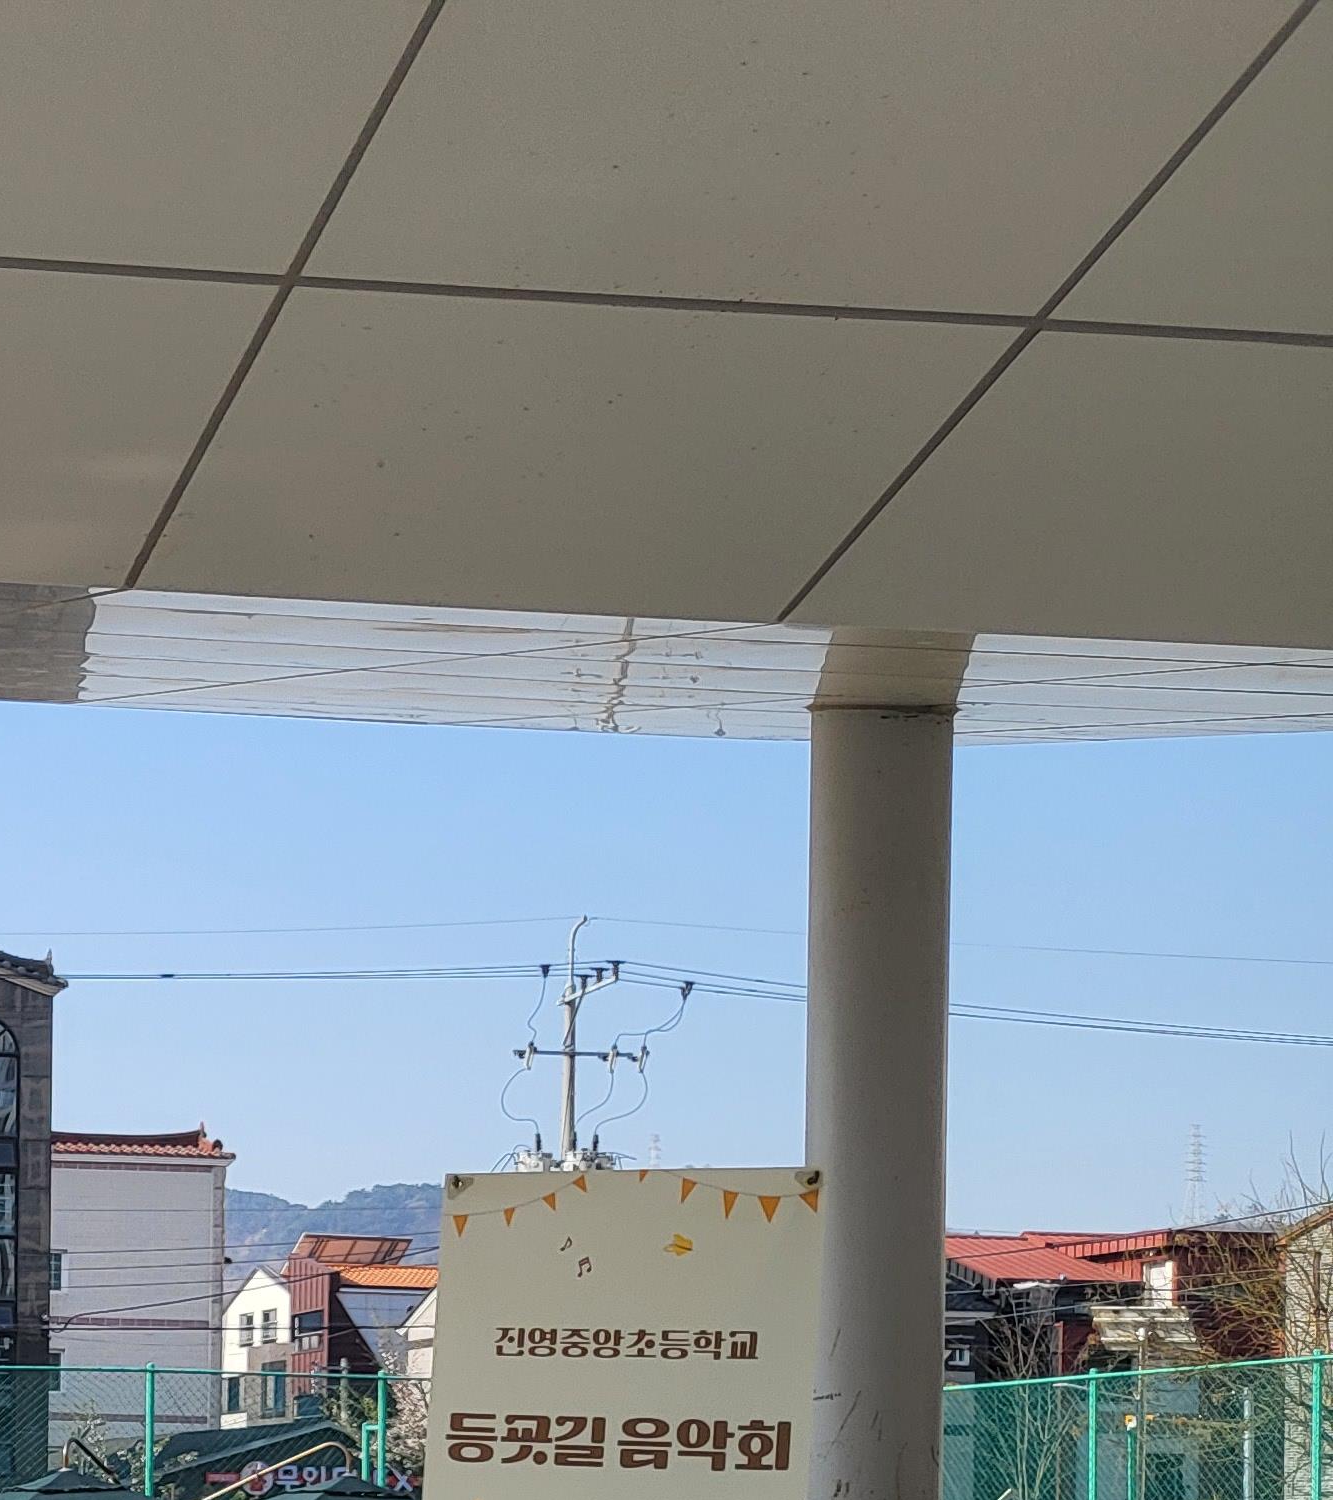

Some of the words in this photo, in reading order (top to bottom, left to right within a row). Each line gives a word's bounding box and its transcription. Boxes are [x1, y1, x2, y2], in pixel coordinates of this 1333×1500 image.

[493, 1327, 759, 1360] 진영중앙초등학교
[445, 1412, 606, 1468] 등굣길
[617, 1417, 792, 1472] 음악회
